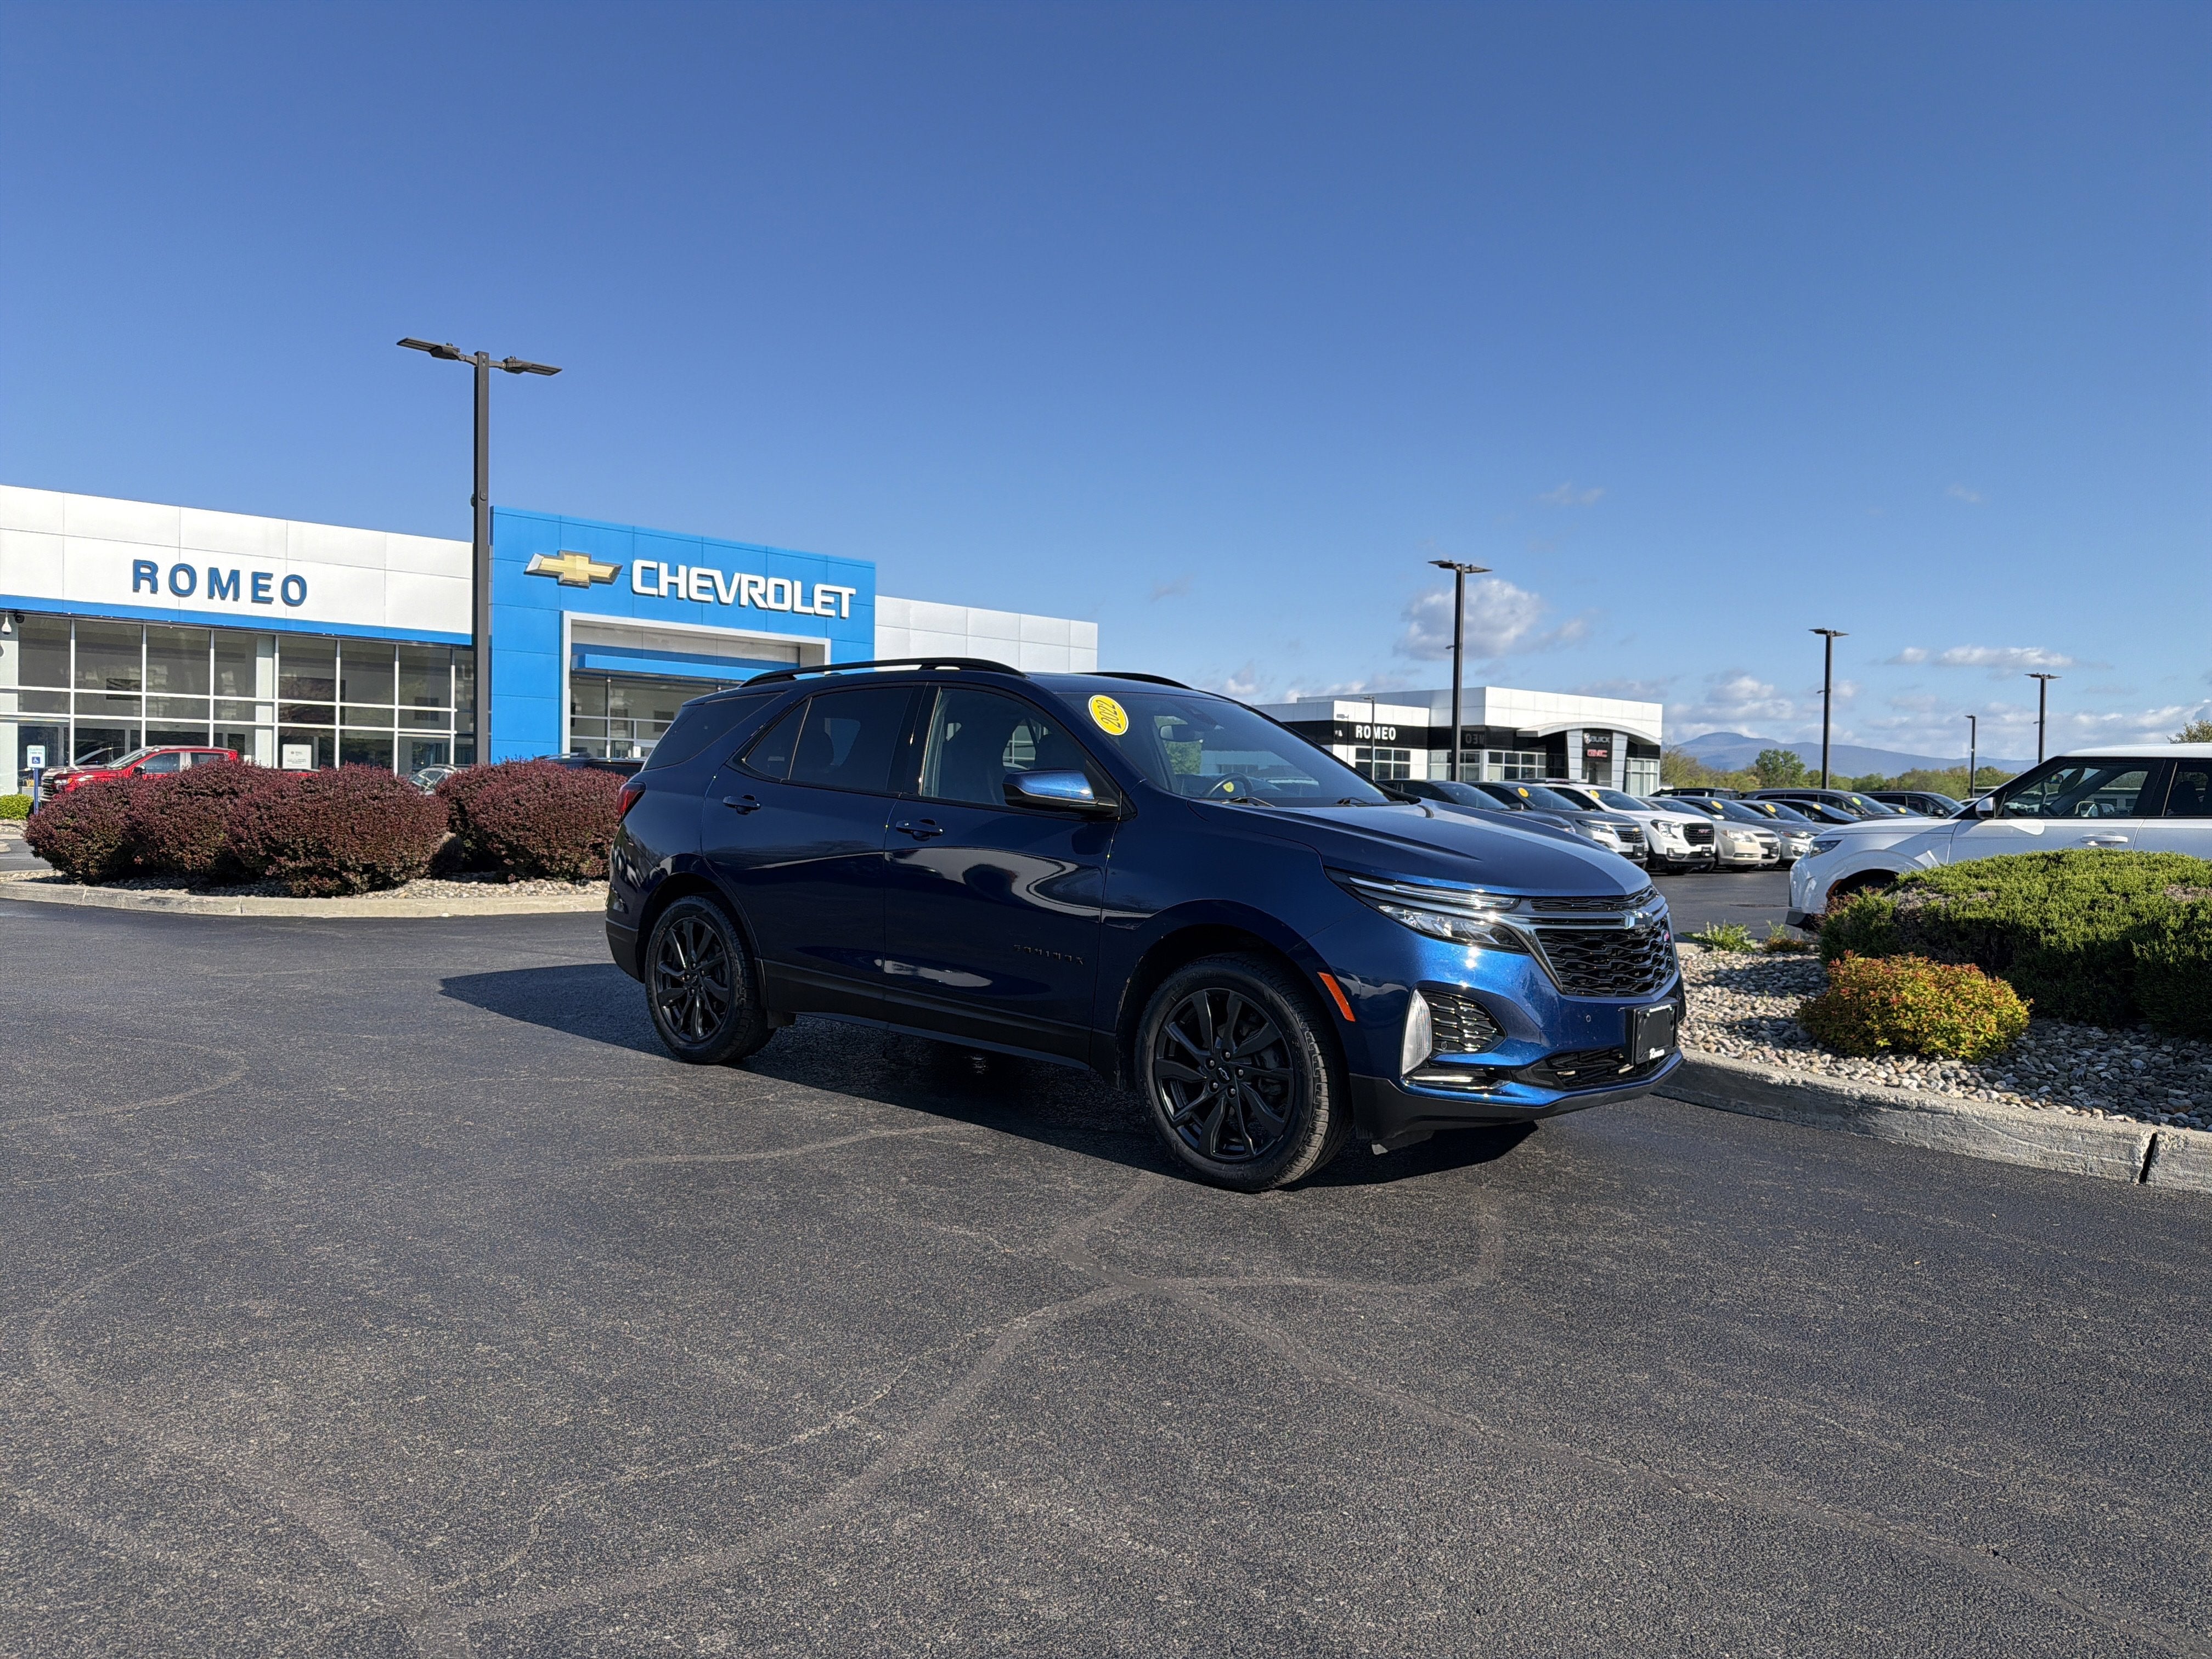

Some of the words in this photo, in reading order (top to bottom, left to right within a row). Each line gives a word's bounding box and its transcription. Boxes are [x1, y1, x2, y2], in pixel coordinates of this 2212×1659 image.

[132, 559, 308, 606] ROMEO
[631, 559, 857, 619] CHEVROLET
[1096, 699, 1121, 729] 2022
[1355, 724, 1396, 741] ROMEO
